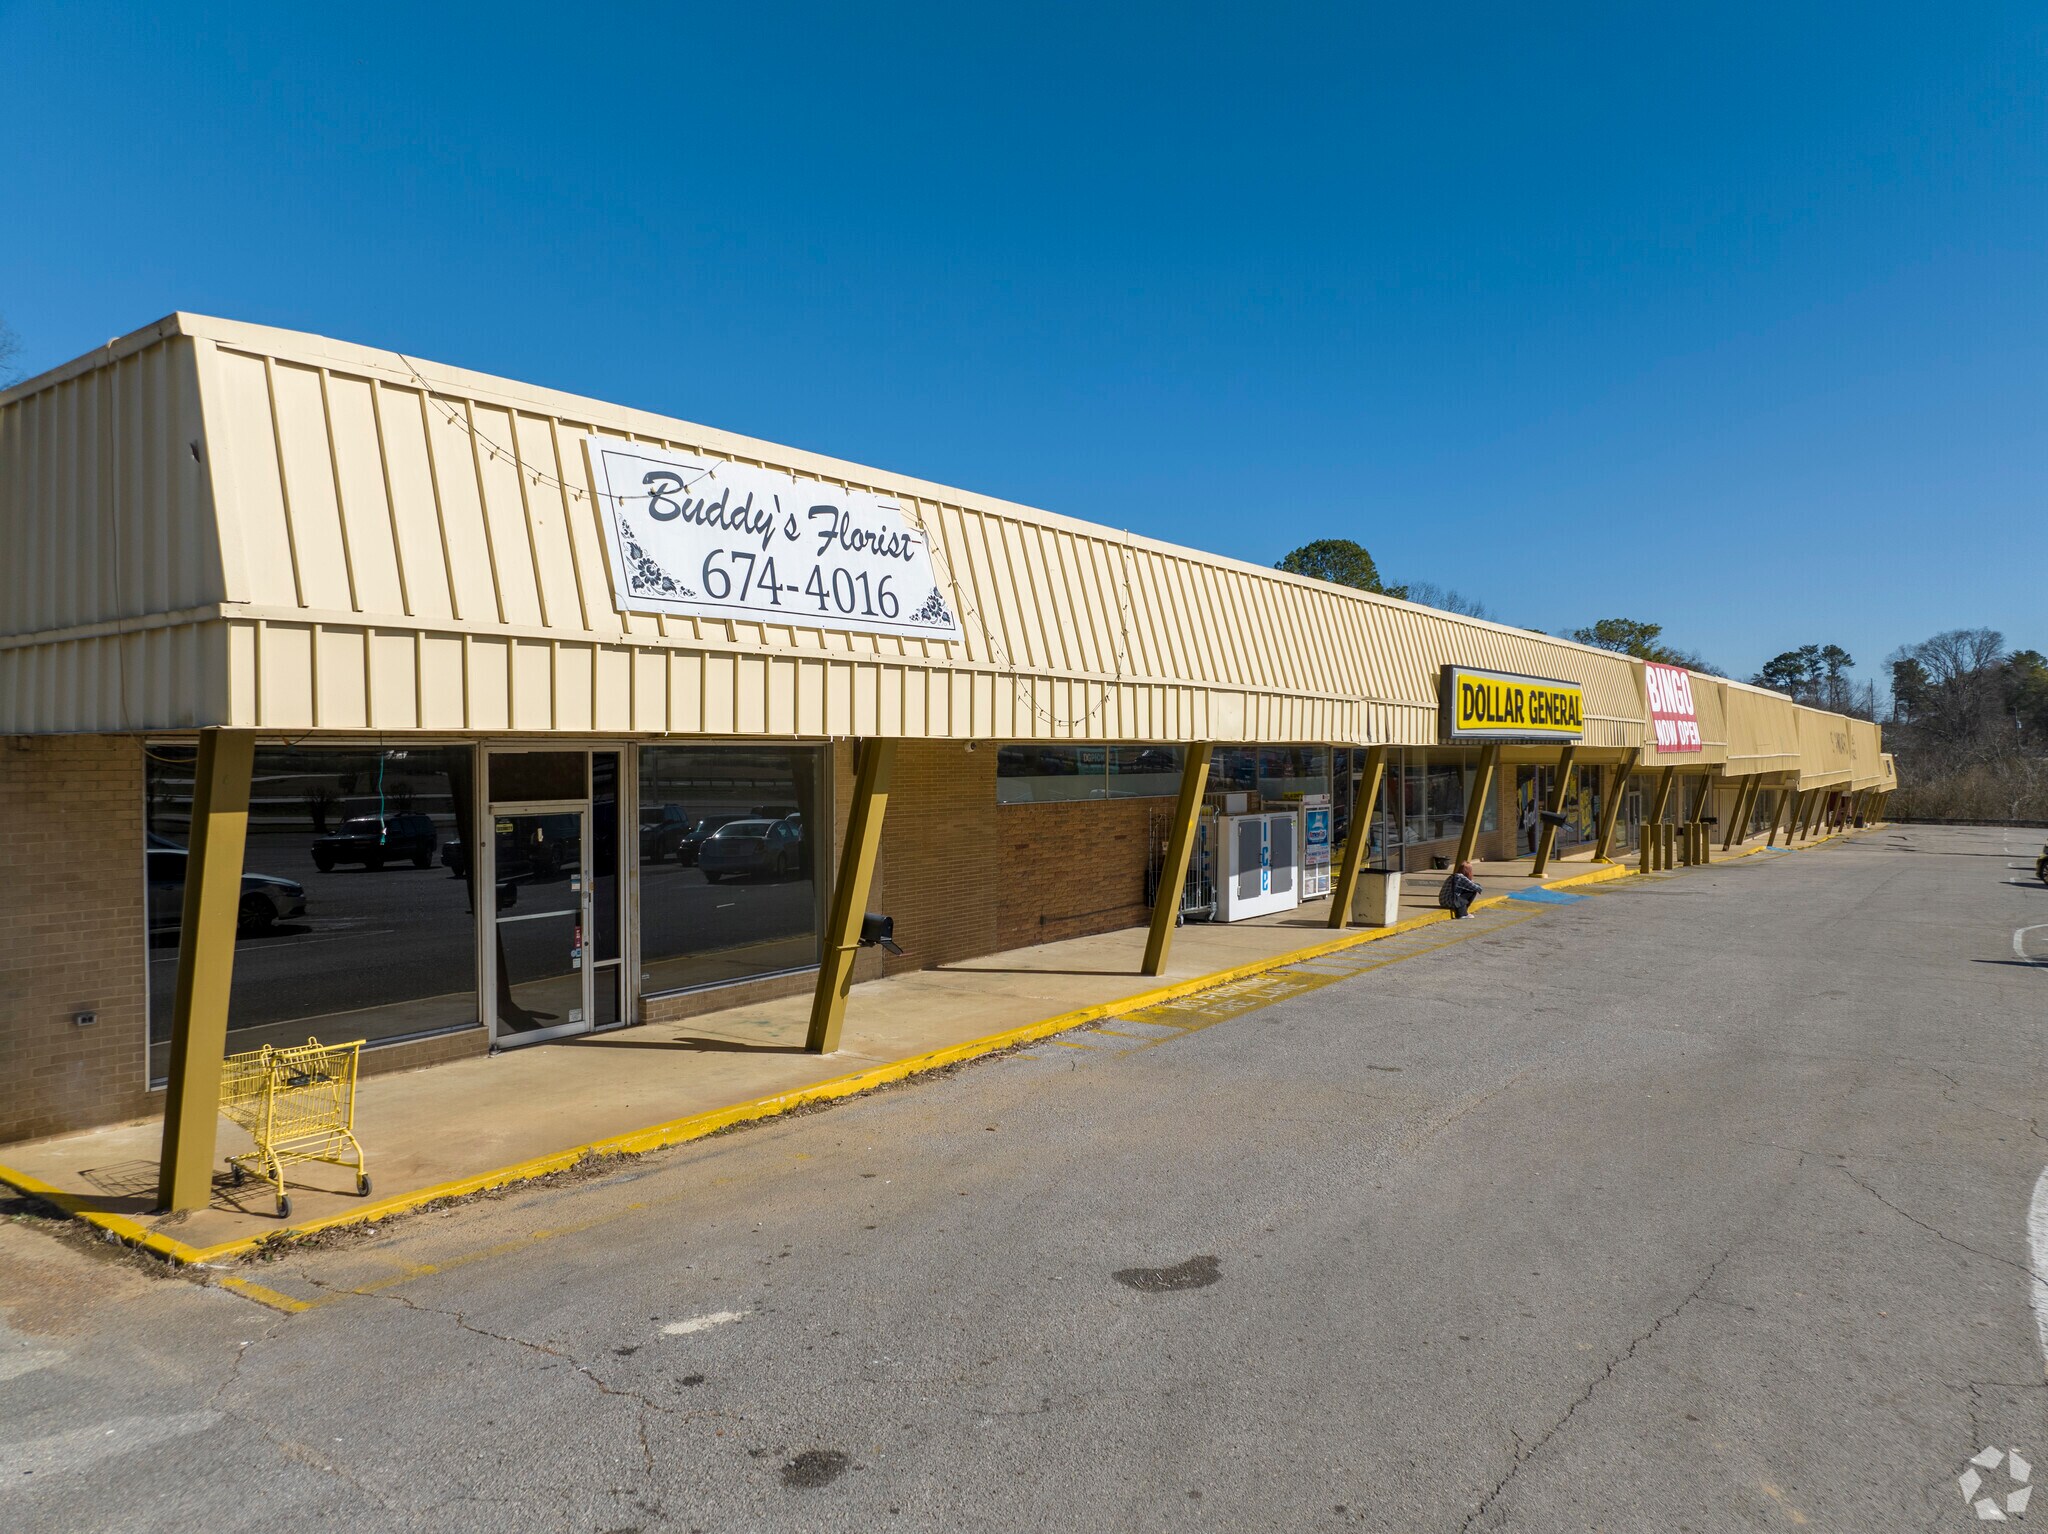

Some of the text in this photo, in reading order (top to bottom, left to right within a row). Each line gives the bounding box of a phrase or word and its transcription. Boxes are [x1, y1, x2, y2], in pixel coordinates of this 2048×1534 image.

[642, 470, 915, 562] Buddy's Florist
[702, 548, 900, 619] 674-4016
[1462, 683, 1582, 727] DOLLAR GENERAL
[1646, 665, 1695, 716] BINGO
[1654, 719, 1701, 746] NOW OPEN
